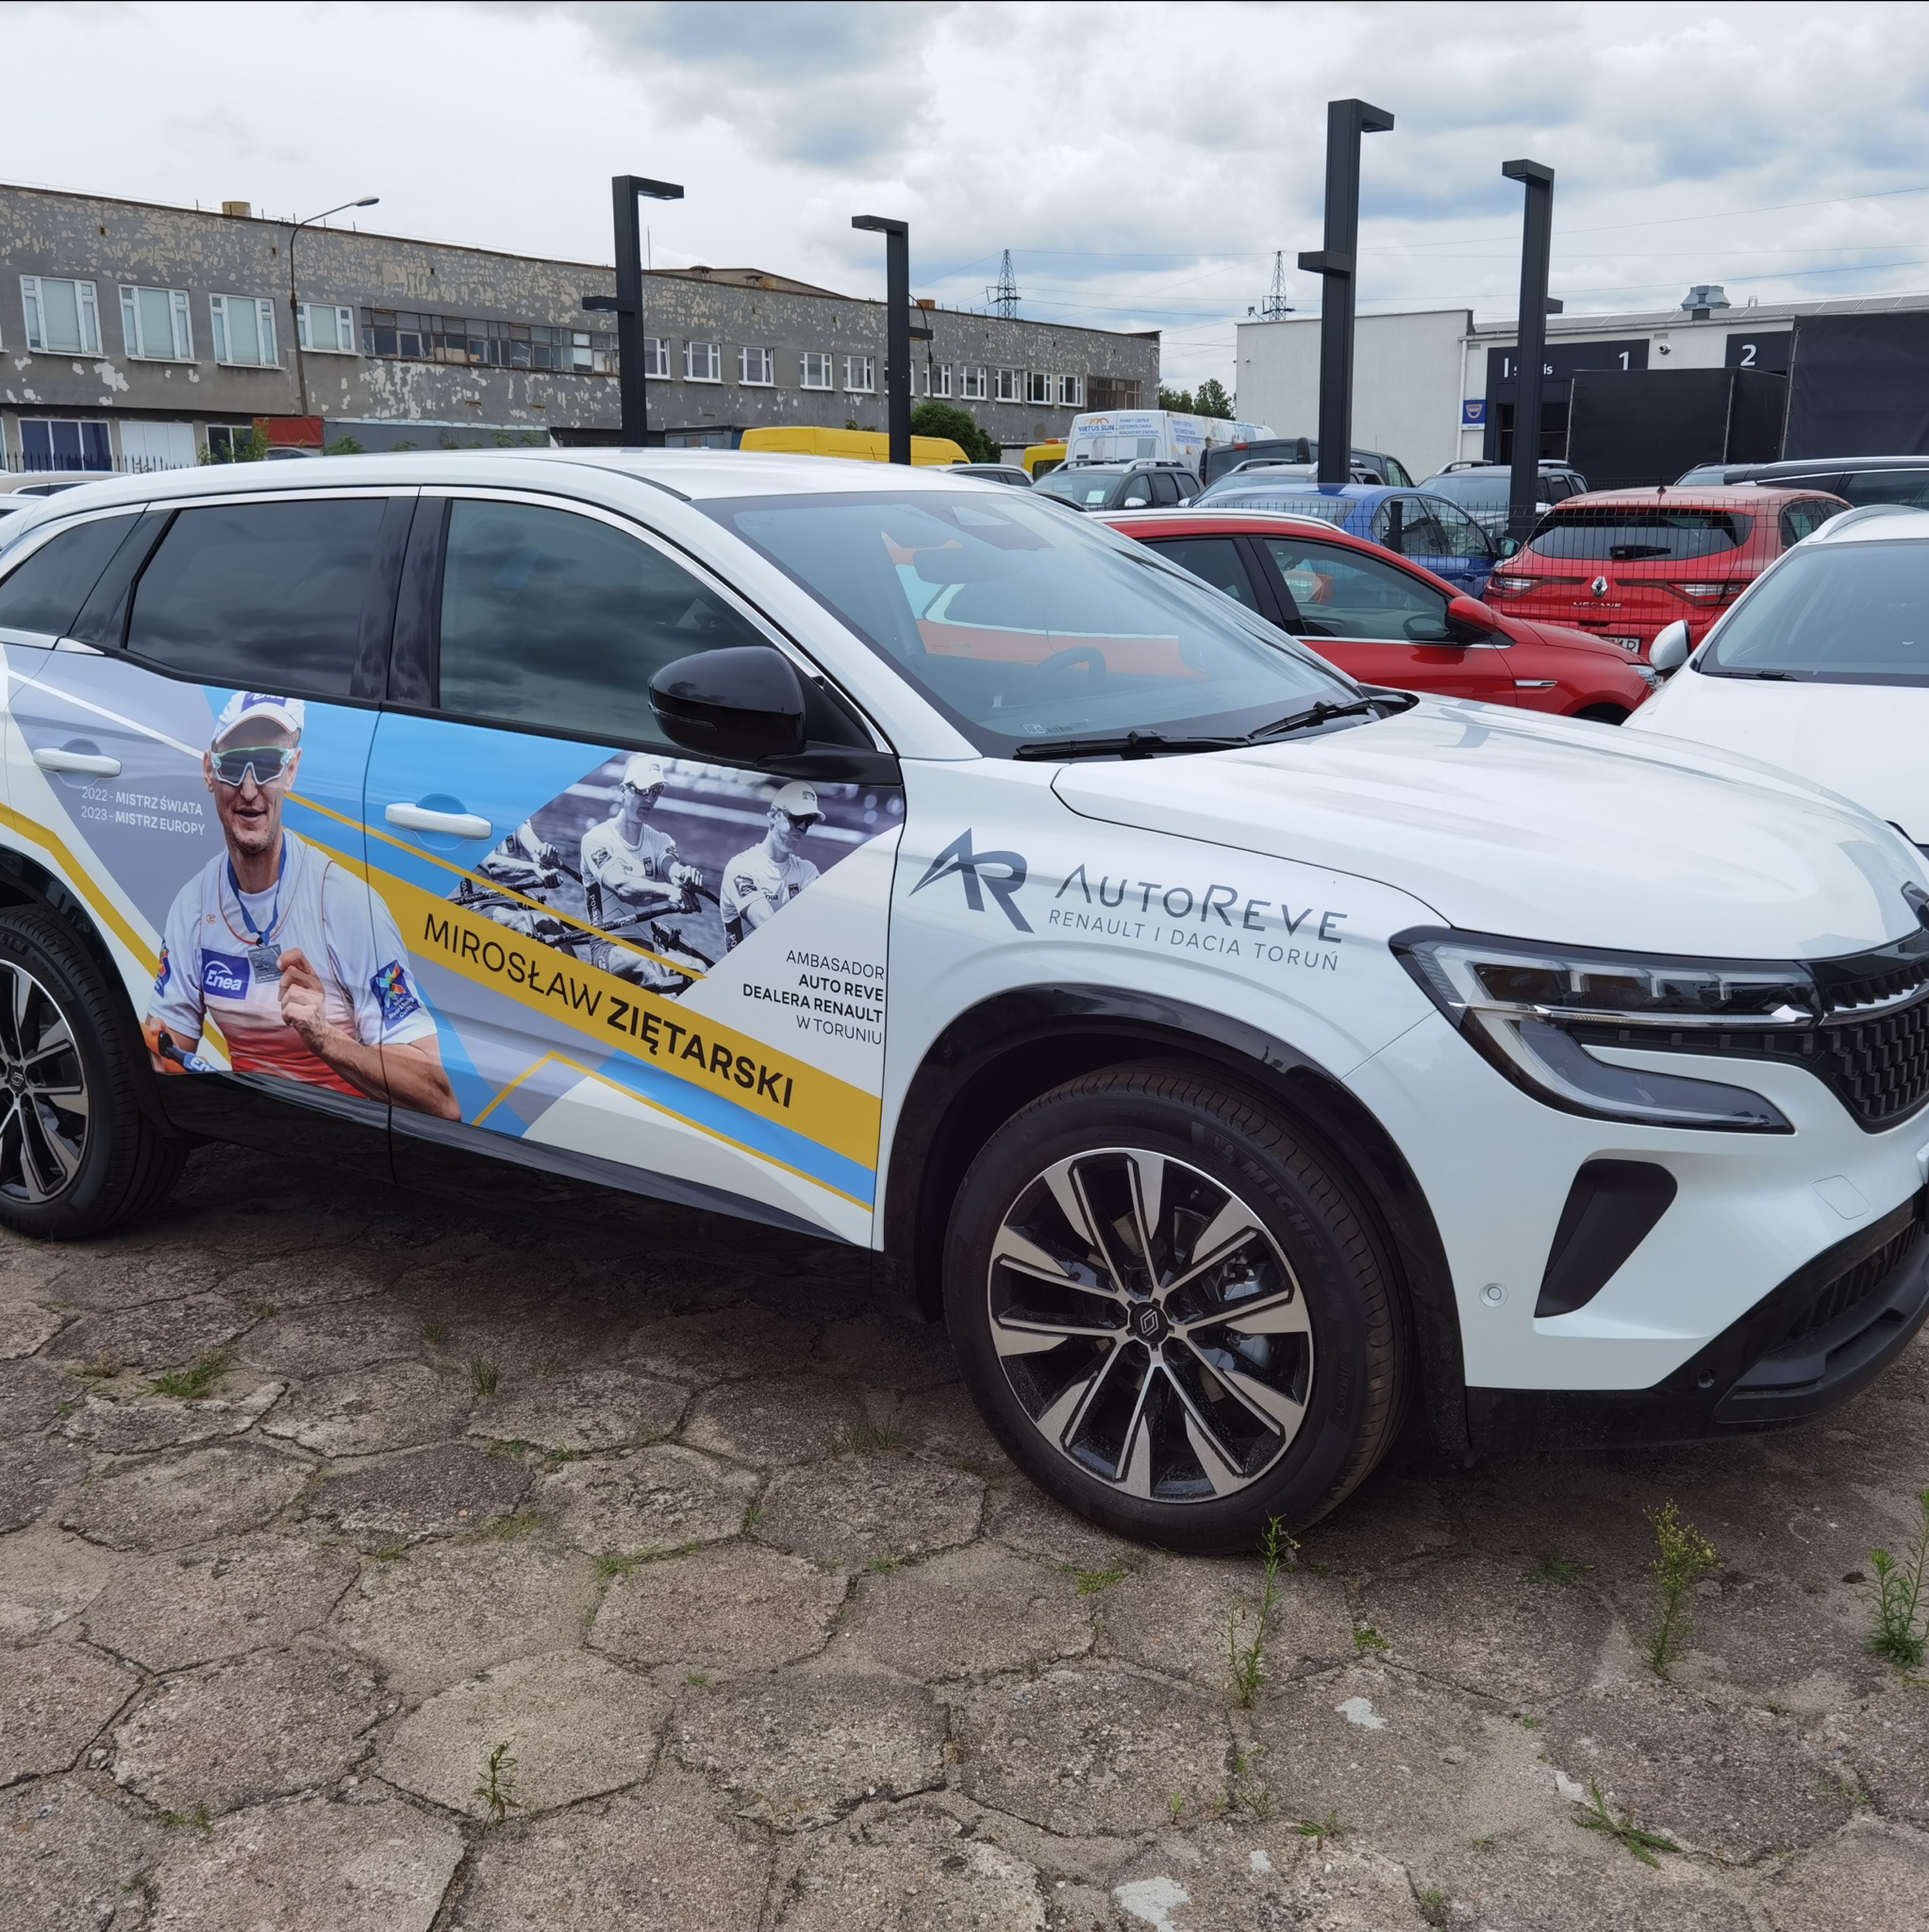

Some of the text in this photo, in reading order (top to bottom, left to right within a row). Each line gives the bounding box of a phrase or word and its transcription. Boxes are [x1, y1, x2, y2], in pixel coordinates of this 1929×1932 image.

[1619, 351, 1630, 370] 1
[1740, 344, 1756, 366] 2
[1101, 424, 1115, 432] SUN
[81, 786, 108, 802] 2022
[115, 791, 158, 809] MISTRZ
[159, 795, 204, 816] ŚWIATA
[81, 806, 108, 821] 2023
[115, 810, 158, 829] MISTRZ
[159, 818, 206, 836] EUROPY
[1048, 908, 1339, 972] RENAULT I DACIA TORUŃ
[786, 950, 885, 980] AMBASADOR
[205, 970, 243, 991] Enea
[798, 974, 884, 1002] AUTO REVE
[424, 913, 794, 1108] MIROSŁAW ZIĘTARSKI
[742, 983, 883, 1023] DEALERA RENAULT
[796, 1014, 882, 1044] W TORUNIU
